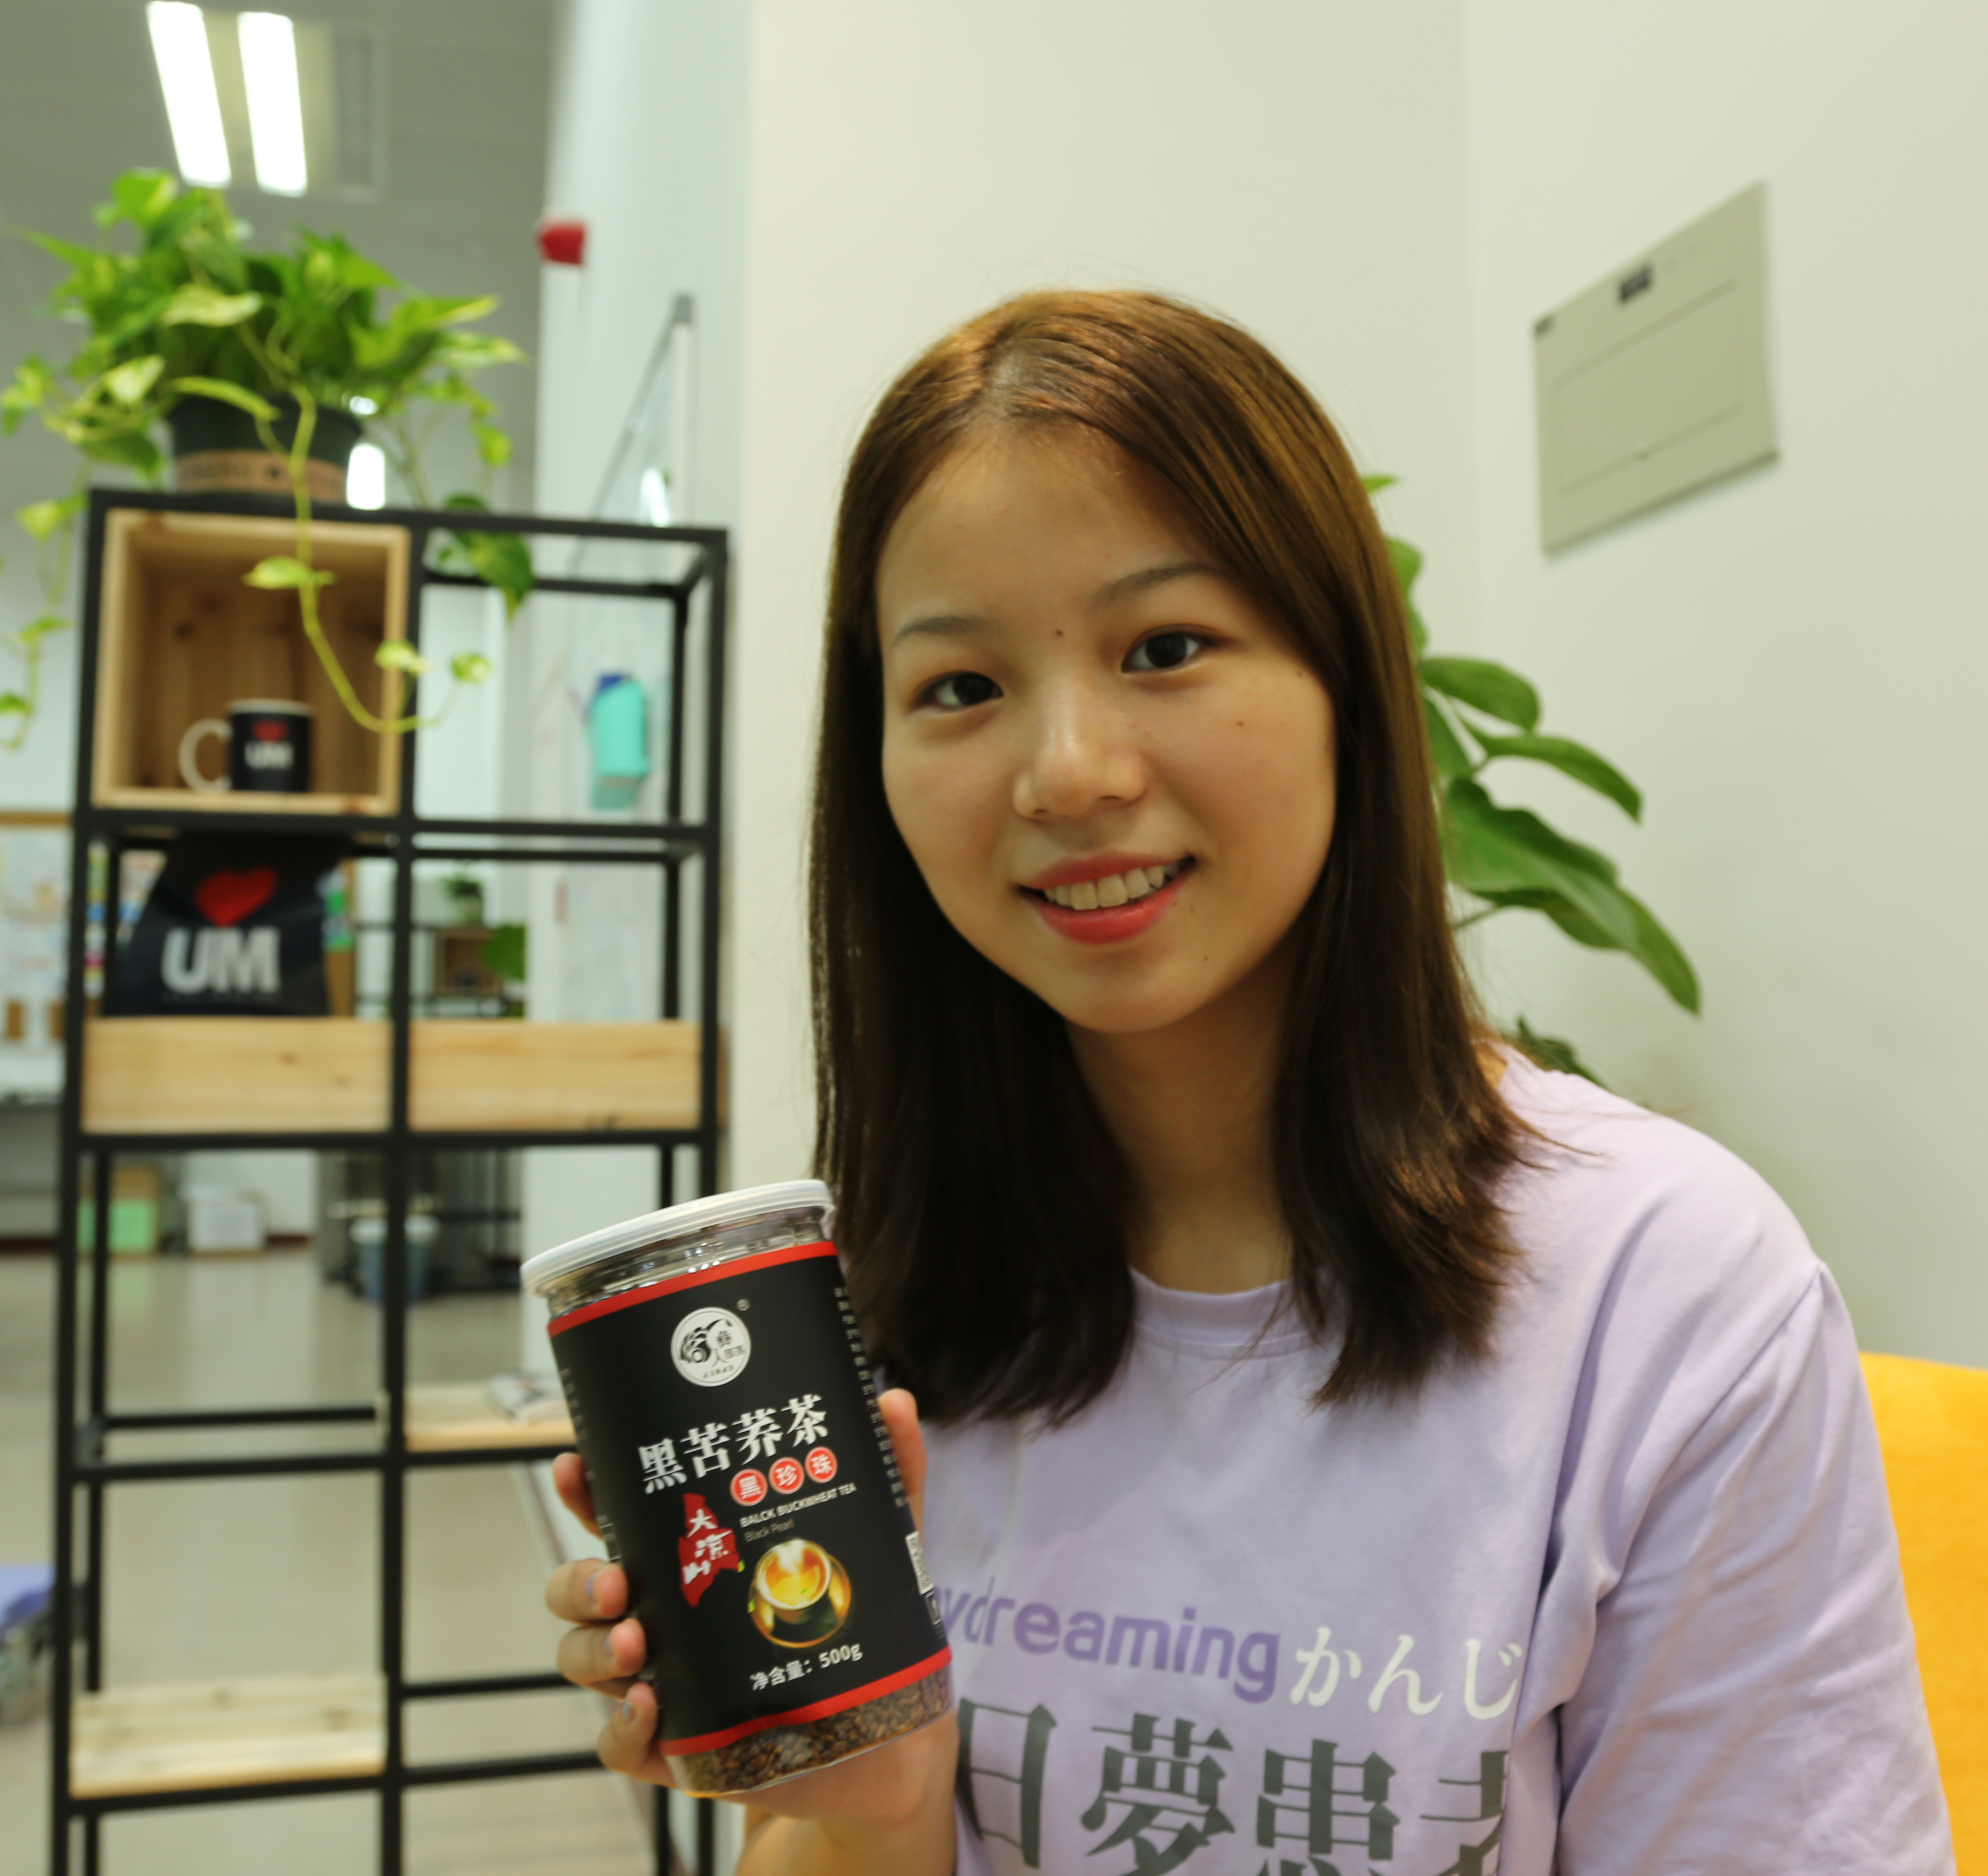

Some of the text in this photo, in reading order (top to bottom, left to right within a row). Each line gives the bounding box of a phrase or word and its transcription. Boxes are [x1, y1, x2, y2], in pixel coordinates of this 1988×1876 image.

[162, 926, 280, 993] UM
[638, 1394, 829, 1494] 黑苦荞茶
[739, 1454, 833, 1500] 黑珍珠
[739, 1483, 857, 1528] BALCK BUCKWHEAT TEA
[744, 1526, 770, 1542] Black
[934, 1575, 1280, 1704] ydreaming
[1290, 1626, 1523, 1720] かんじ
